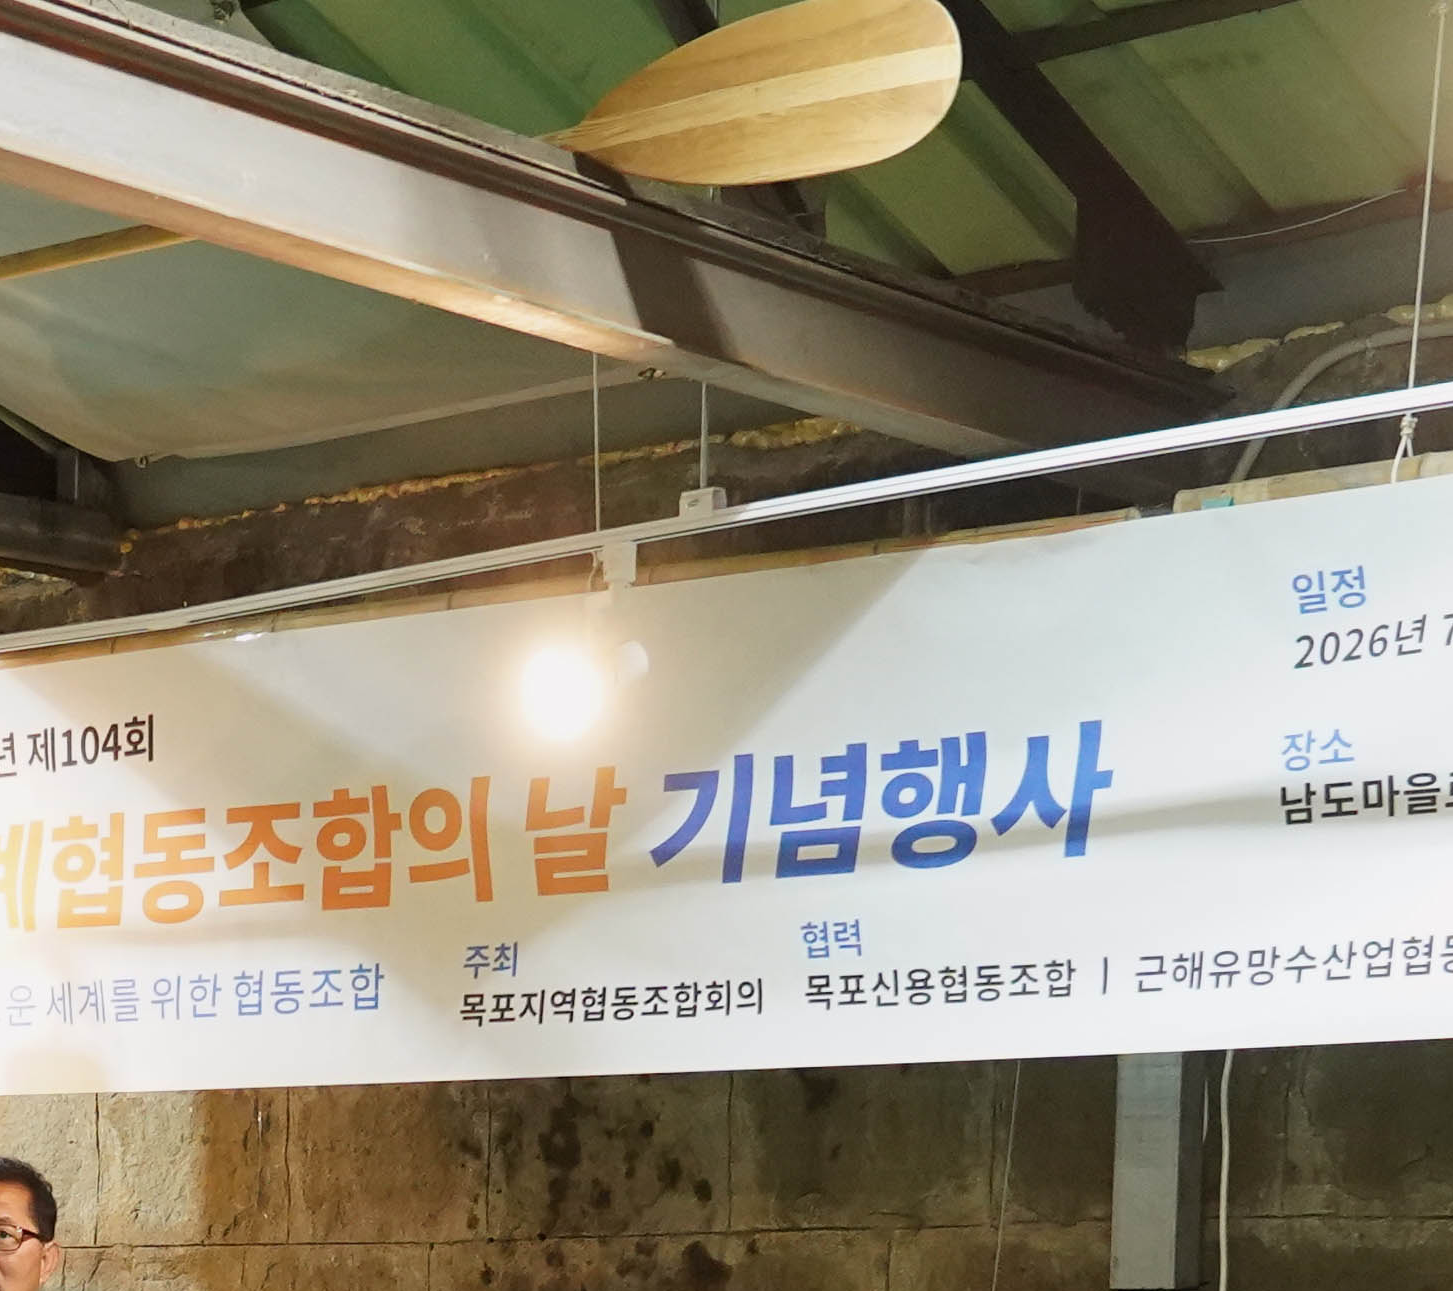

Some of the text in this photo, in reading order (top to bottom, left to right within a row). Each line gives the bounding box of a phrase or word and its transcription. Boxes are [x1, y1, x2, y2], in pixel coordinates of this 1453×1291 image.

[1291, 565, 1368, 615] 일정
[1294, 614, 1427, 670] 2026년
[27, 713, 156, 774] 제104회
[1281, 728, 1356, 773] 장소
[525, 766, 628, 897] 날
[649, 720, 1115, 884] 기념행사
[462, 941, 520, 979] 주최
[799, 918, 864, 960] 협력
[46, 976, 141, 1025] 세계를
[150, 971, 222, 1021] 위한
[232, 961, 386, 1018] 협동조합
[459, 976, 765, 1028] 목포지역협동조합회의
[805, 958, 1078, 1011] 목포신용협동조합
